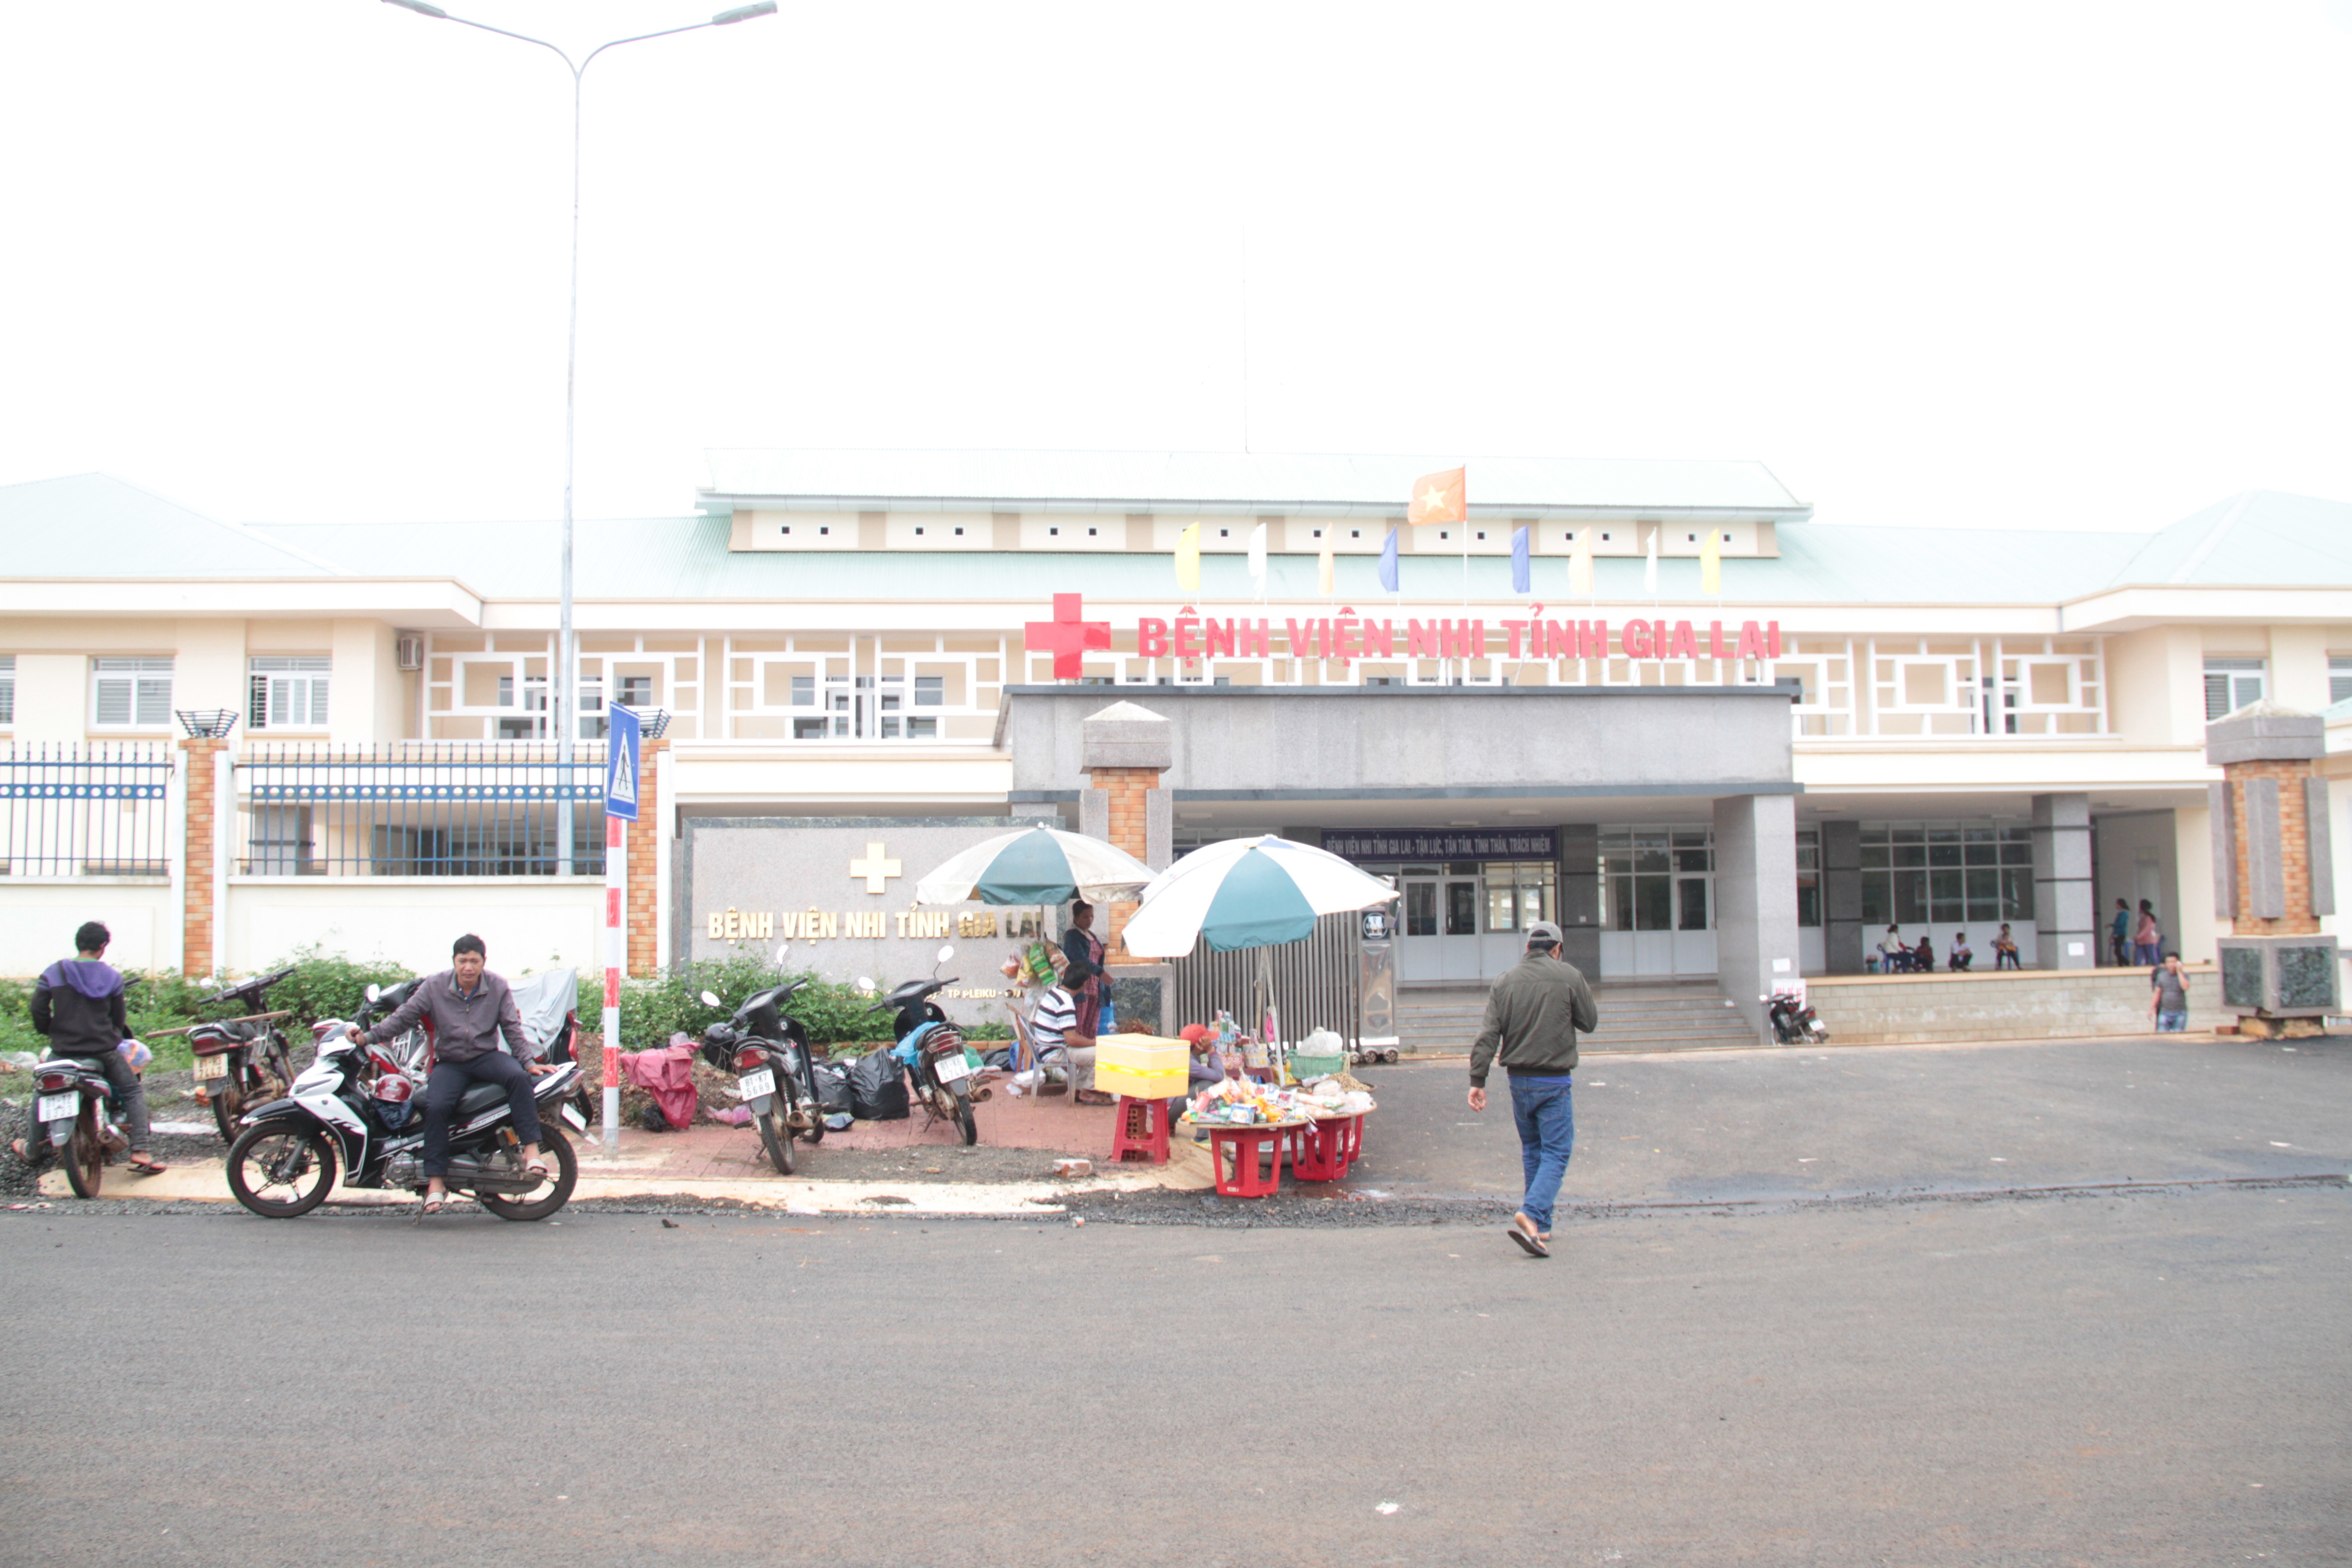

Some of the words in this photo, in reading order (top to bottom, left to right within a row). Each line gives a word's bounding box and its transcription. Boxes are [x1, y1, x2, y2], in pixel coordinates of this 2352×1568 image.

[1139, 606, 1269, 667] BỆNH
[1285, 607, 1392, 667] VIỆN
[1408, 618, 1485, 658] NHI
[1499, 603, 1608, 658] TỈNH
[1622, 619, 1699, 658] GIA
[1710, 620, 1781, 658] LAI
[1361, 839, 1372, 854] NHI
[1389, 839, 1399, 854] GIA
[1401, 839, 1411, 854] LAI
[708, 906, 773, 945] BỆNH
[782, 906, 837, 945] VIỆN
[845, 912, 886, 938] NHI
[895, 902, 949, 938] TỈNH
[958, 911, 997, 938] GIA
[1006, 911, 1042, 937] LAI
[962, 989, 996, 998] PLEIKU
[745, 1073, 767, 1087] 81-K7
[747, 1082, 770, 1097] 5689
